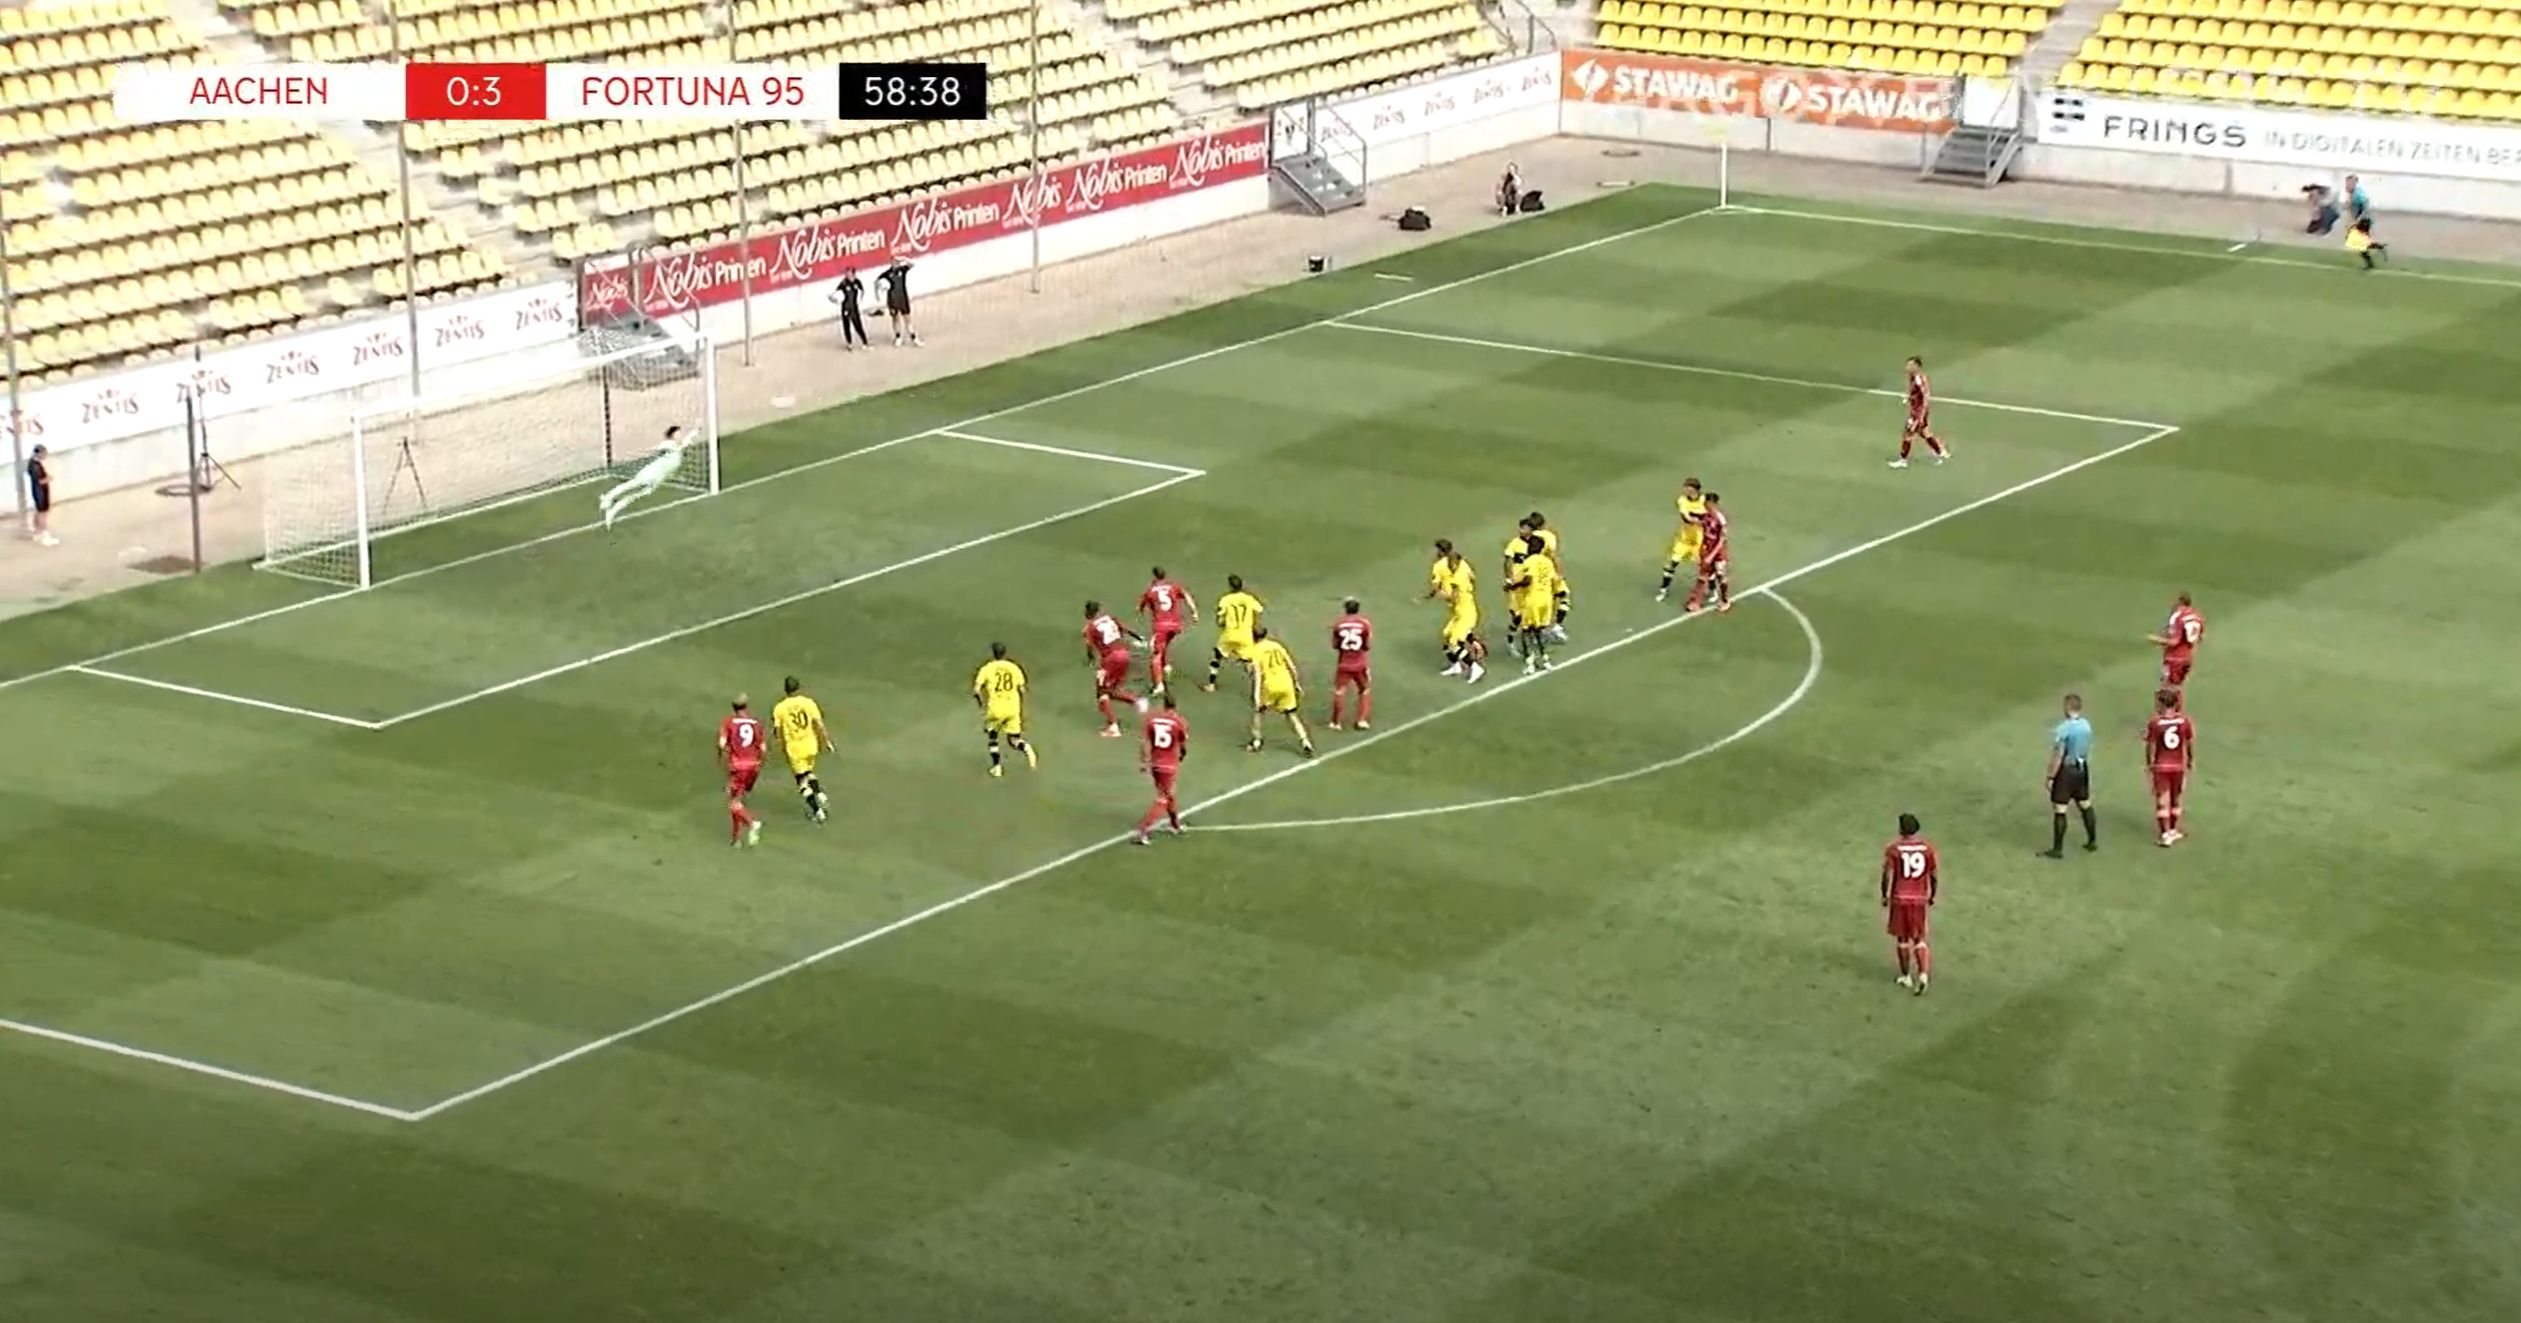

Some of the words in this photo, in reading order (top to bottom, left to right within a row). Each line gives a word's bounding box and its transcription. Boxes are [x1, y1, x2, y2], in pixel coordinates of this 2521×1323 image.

[1613, 65, 1739, 104] STAWAG
[1806, 83, 1942, 122] STAWAG
[2103, 115, 2247, 148] FRINGS
[1169, 134, 1225, 187] Nobis
[1223, 140, 1267, 167] Printen
[1066, 157, 1123, 211] Nobis
[1124, 164, 1168, 190] Printen
[890, 196, 951, 252] Nobis
[953, 202, 1000, 231] Printen
[770, 223, 836, 281] Nobis
[836, 230, 886, 259] Printen
[643, 252, 715, 310] Nobis
[714, 255, 767, 286] Prinen
[1158, 589, 1172, 612] 5
[1338, 628, 1364, 651] 25
[994, 671, 1014, 693] 28
[739, 723, 754, 748] 9
[788, 709, 808, 733] 30
[1153, 724, 1172, 748] 15
[2164, 725, 2180, 750] 6
[1901, 851, 1926, 878] 19
